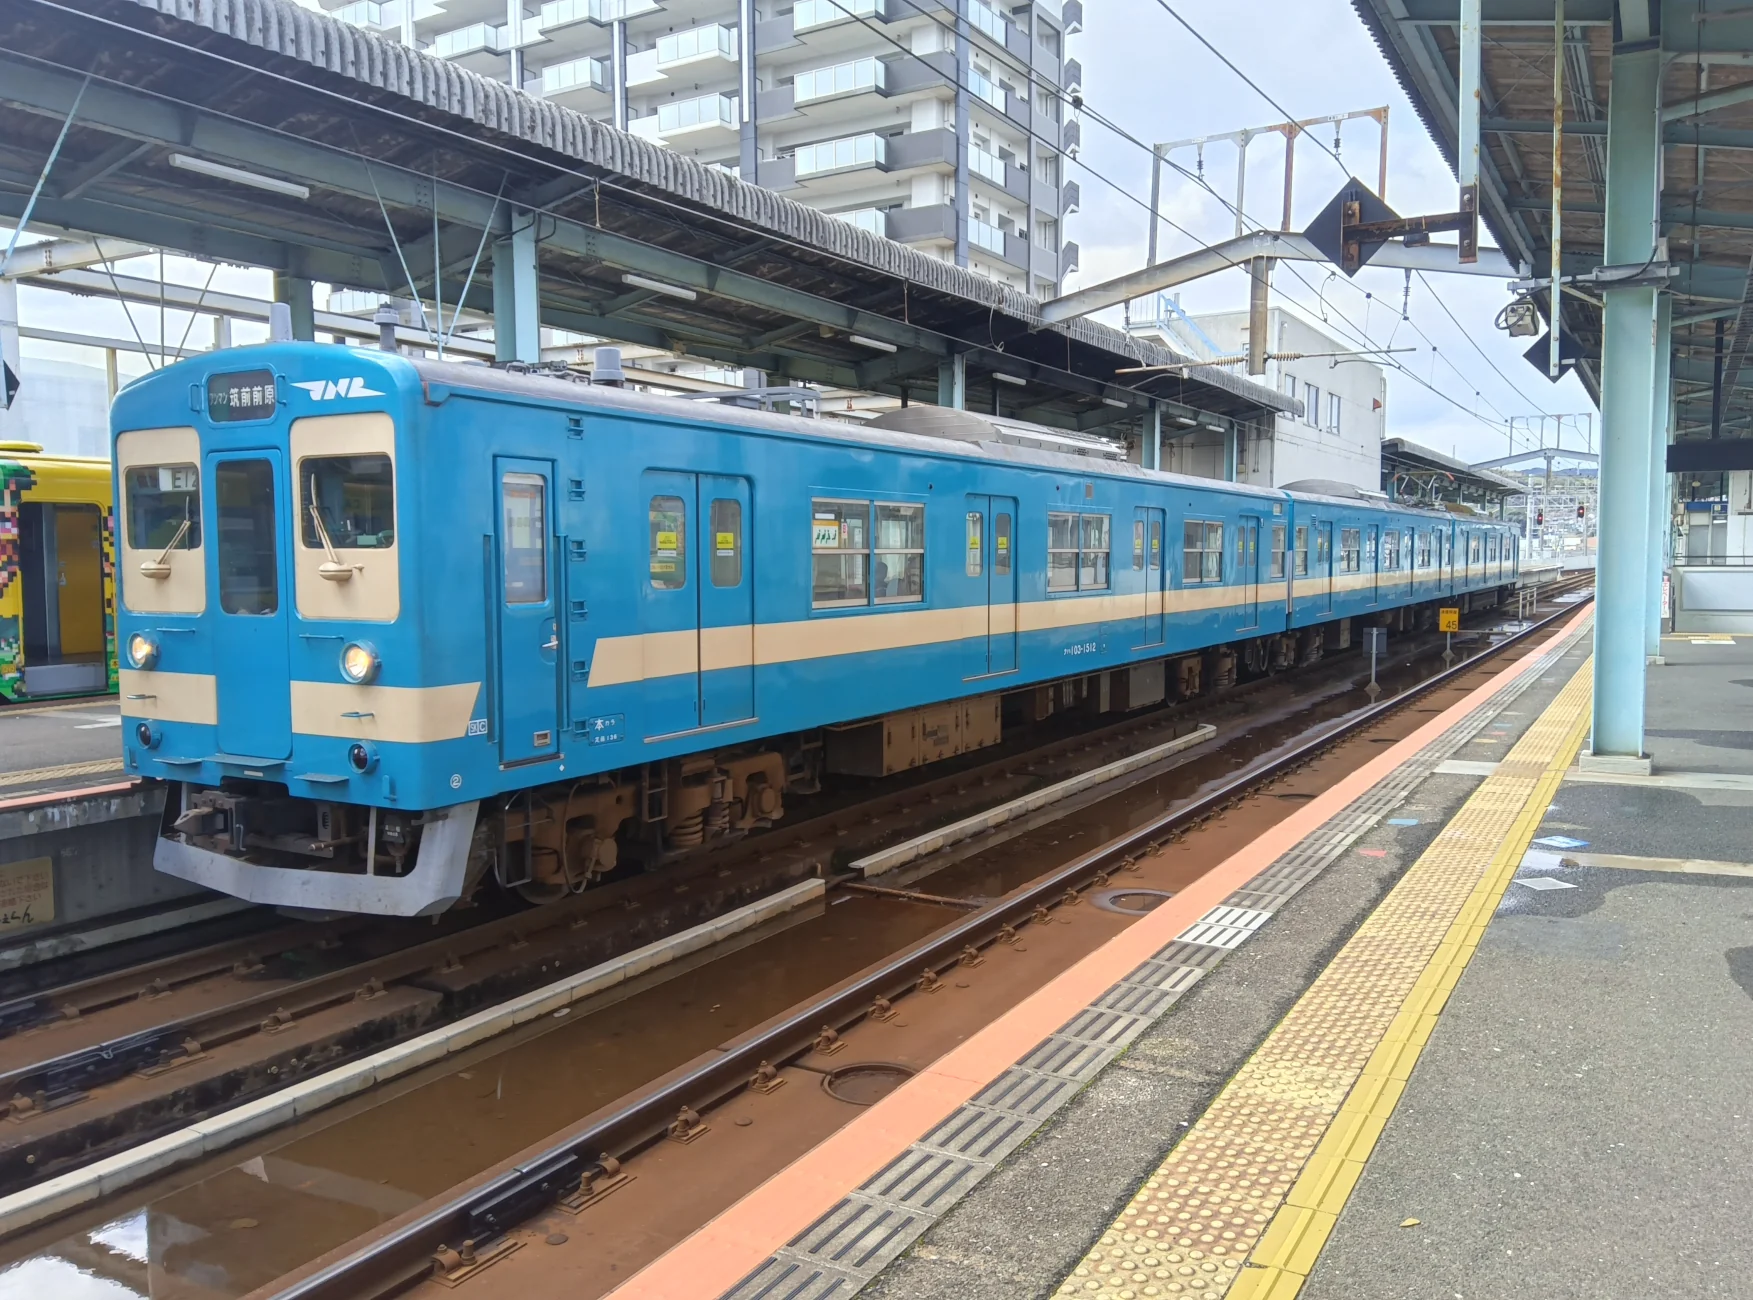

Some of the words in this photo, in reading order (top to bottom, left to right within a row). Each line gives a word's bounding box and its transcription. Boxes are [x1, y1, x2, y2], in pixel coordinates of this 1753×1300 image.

[229, 384, 274, 407] 筑前前原
[1446, 620, 1457, 630] 45
